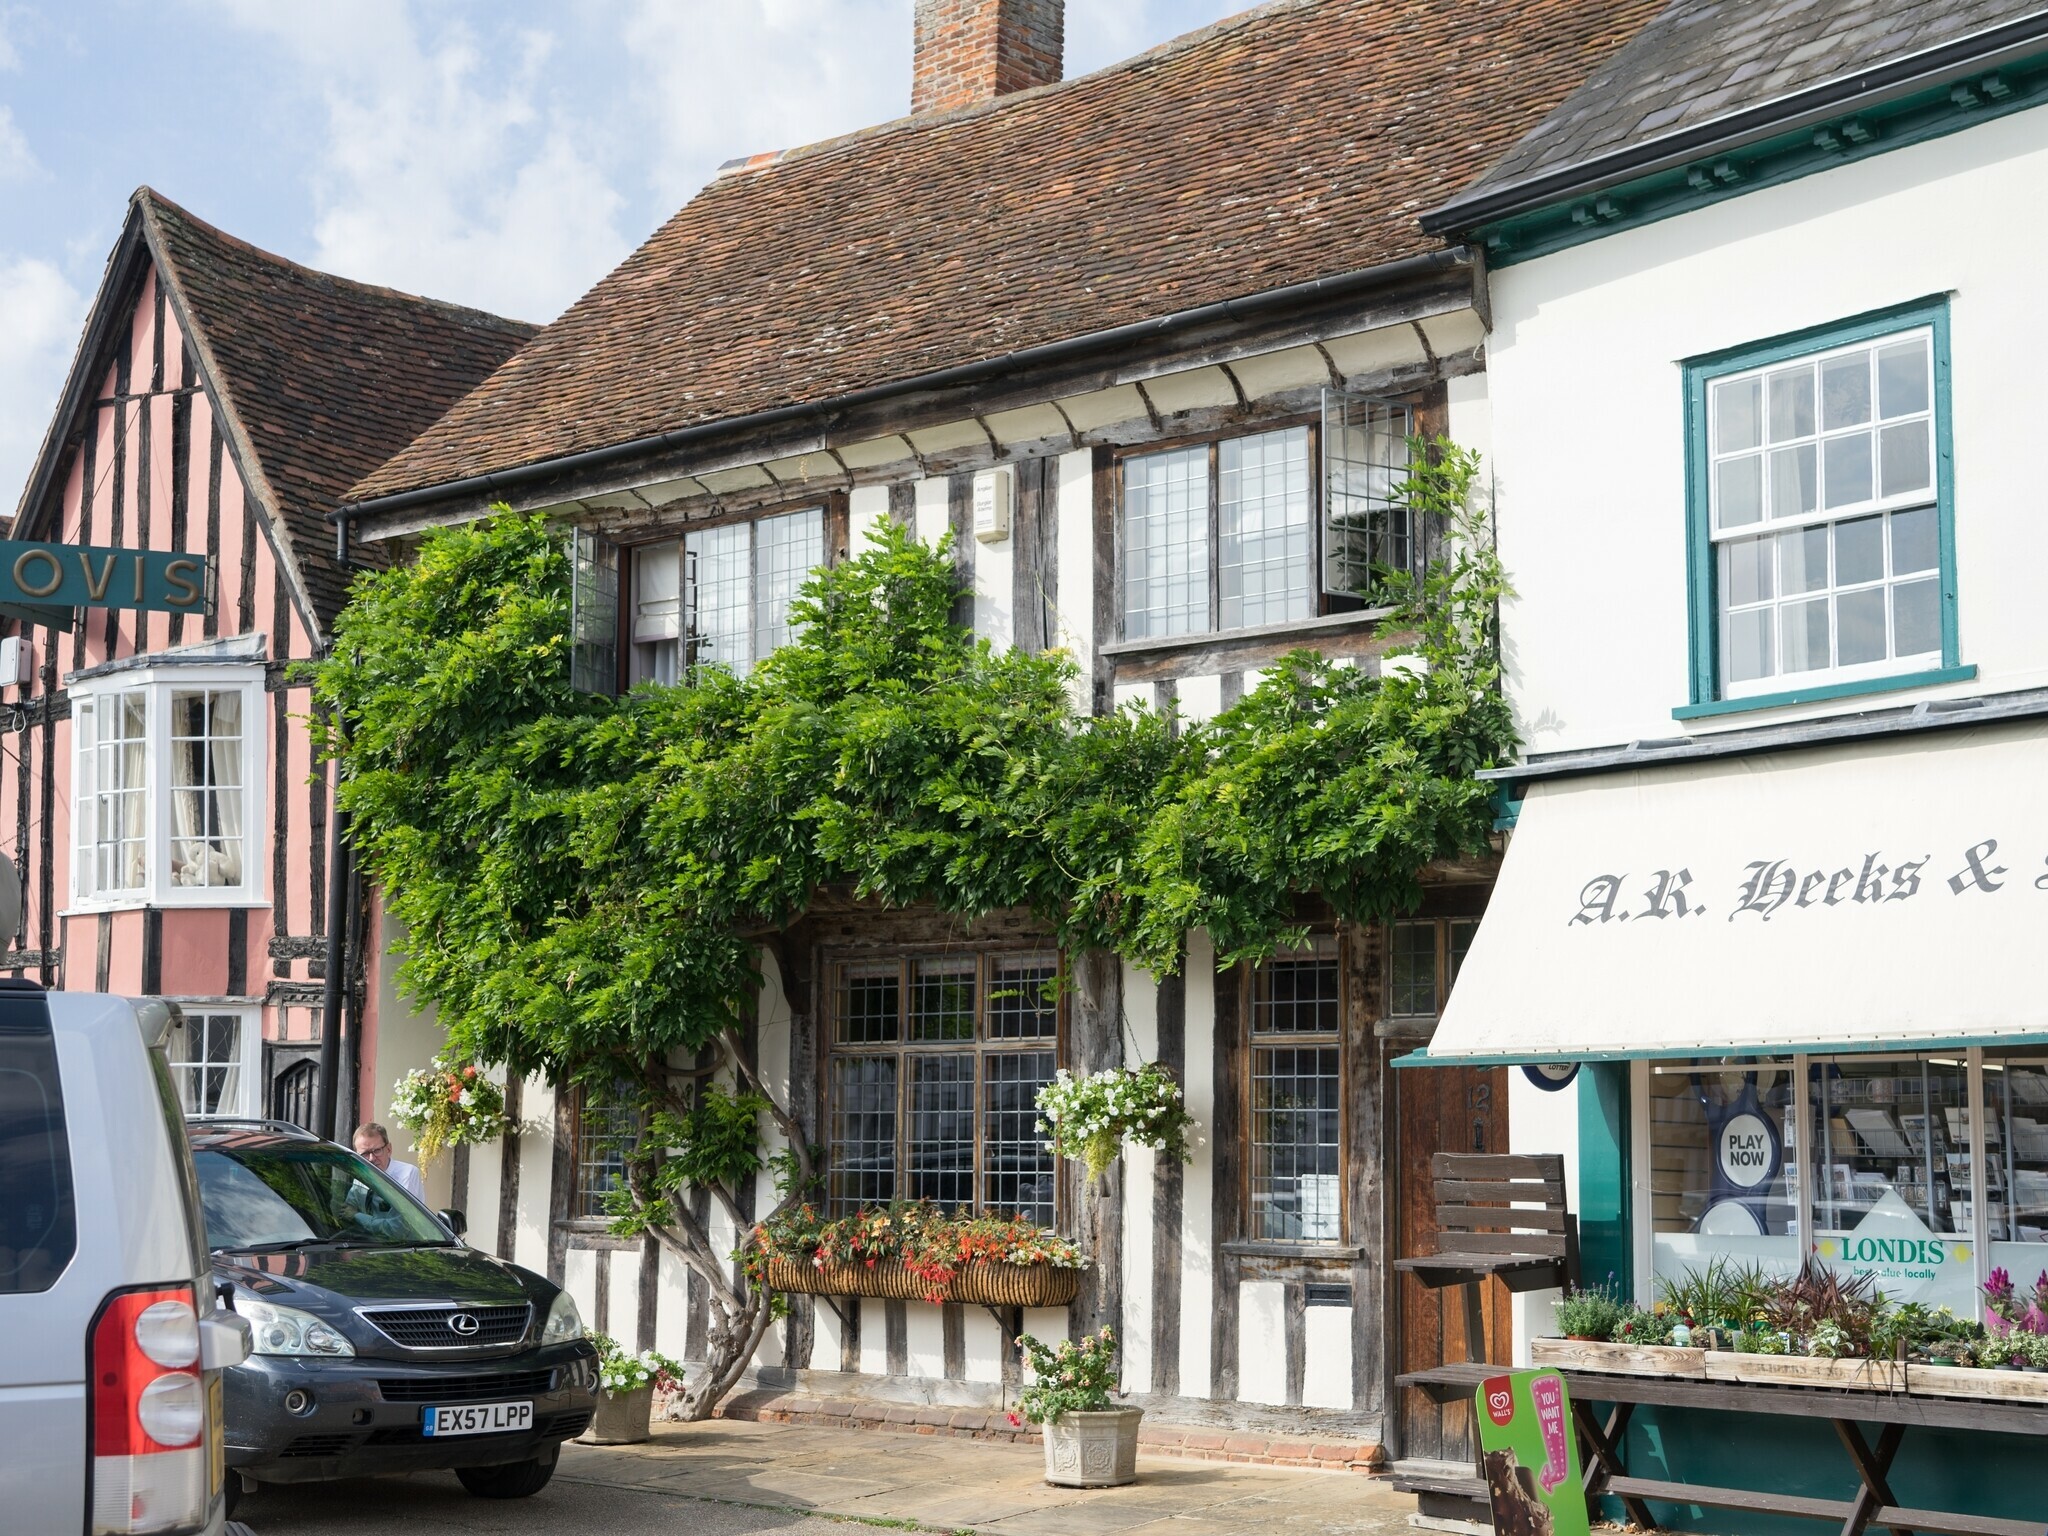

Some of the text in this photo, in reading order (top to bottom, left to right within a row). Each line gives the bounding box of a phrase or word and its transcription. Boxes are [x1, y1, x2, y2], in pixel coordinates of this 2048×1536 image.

[1568, 867, 1706, 927] A.R.
[1728, 851, 1931, 922] Heeks
[1947, 838, 2009, 896] &
[1729, 1135, 1764, 1149] PLAY
[1730, 1151, 1764, 1166] NOW
[1841, 1237, 1945, 1264] LONDIS
[1904, 1268, 1936, 1280] locally
[1541, 1392, 1555, 1406] YOU
[438, 1405, 530, 1431] EX57 LPP
[1493, 1408, 1511, 1417] WALL'S
[1541, 1406, 1560, 1420] WANT
[1548, 1421, 1559, 1435] ME
